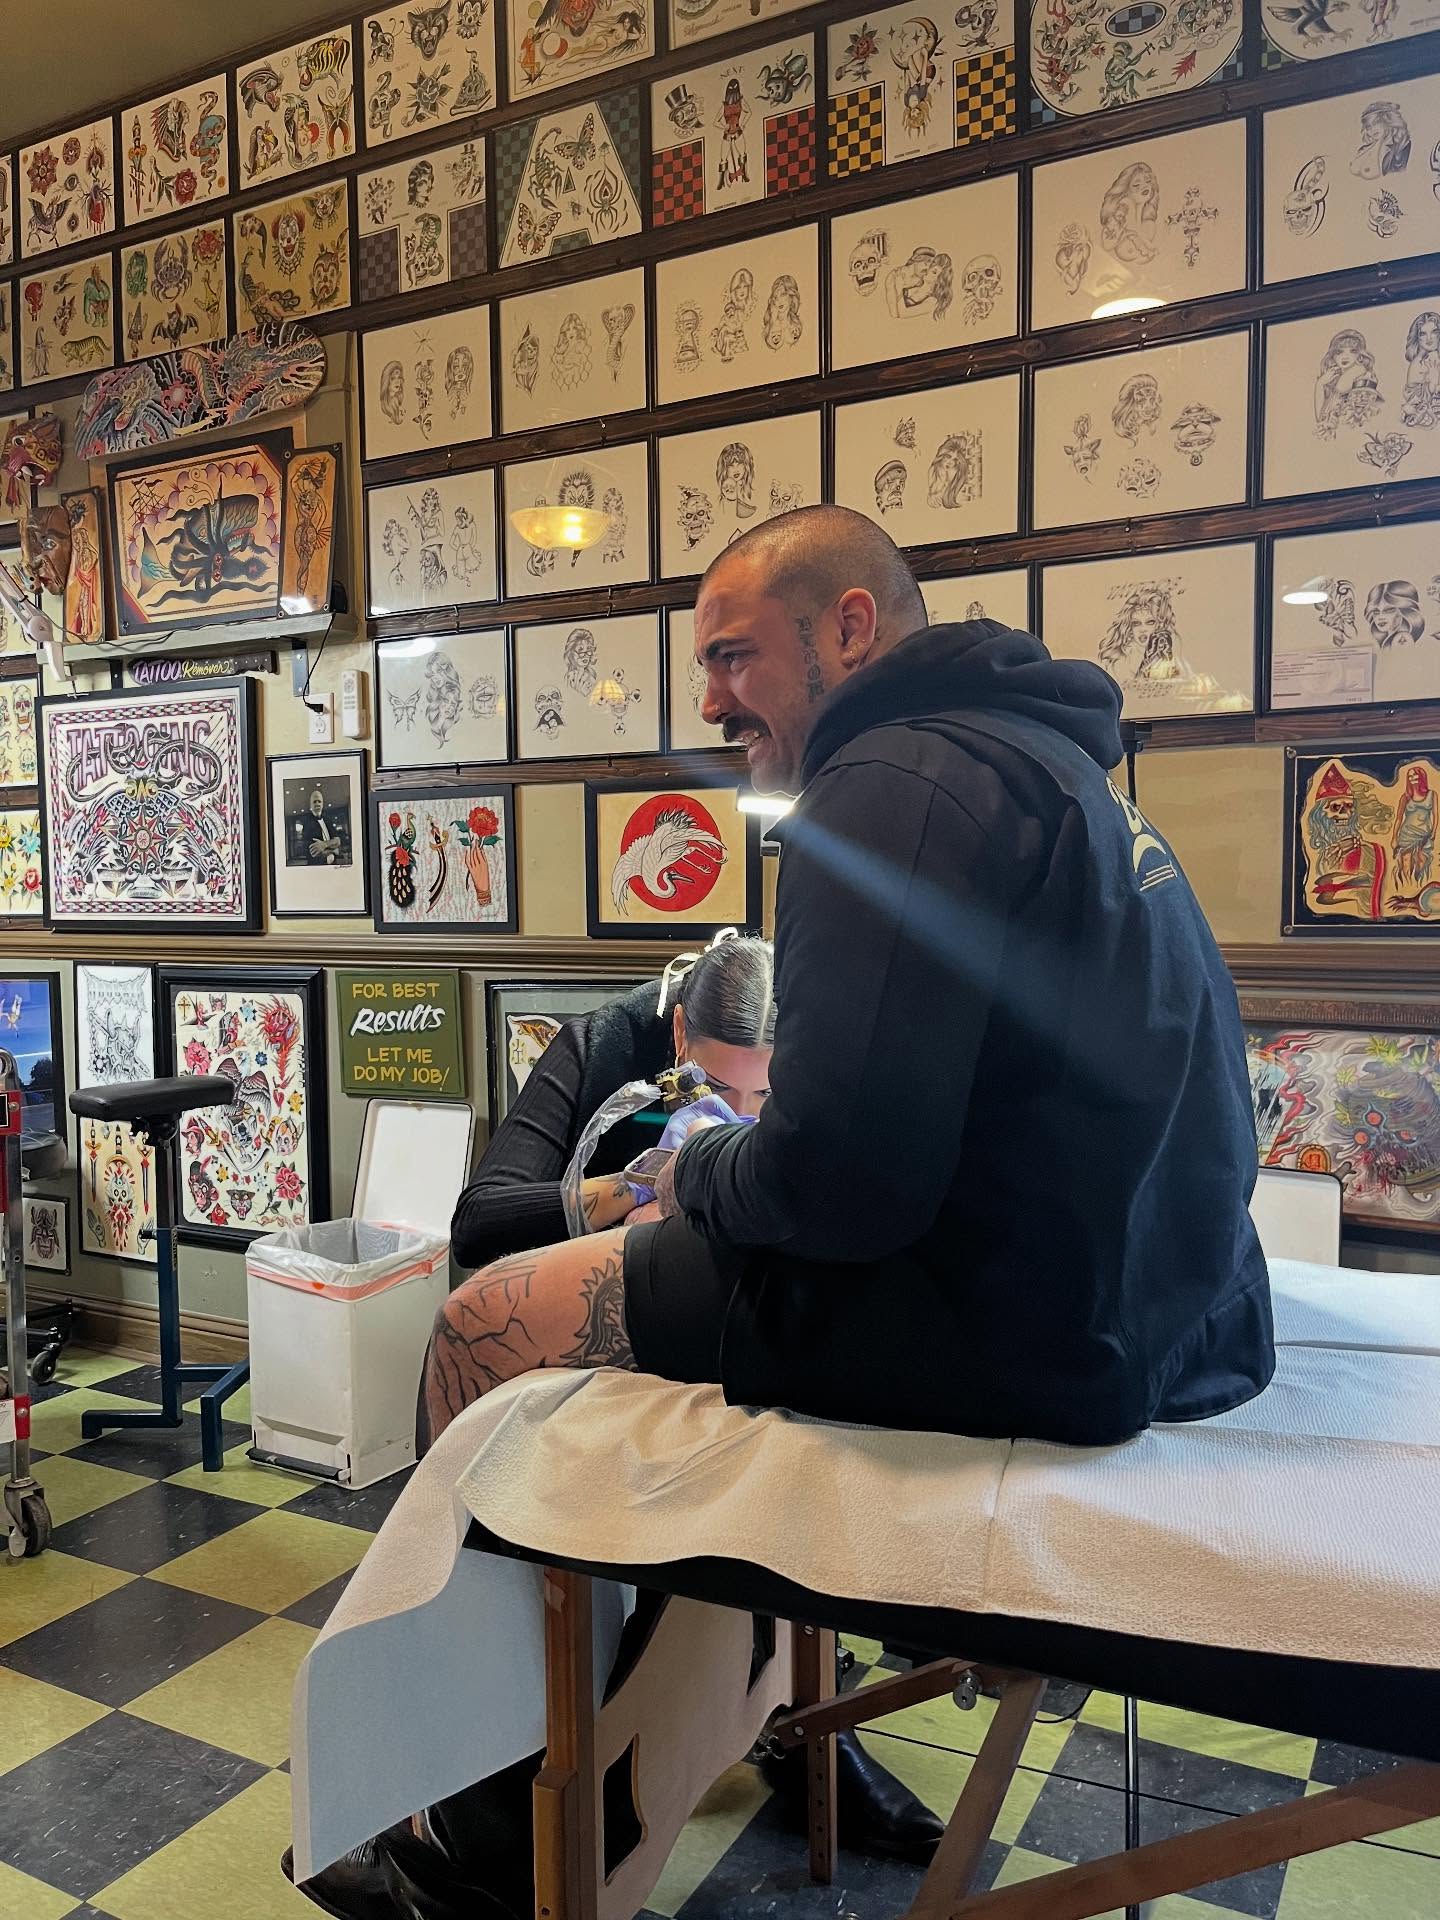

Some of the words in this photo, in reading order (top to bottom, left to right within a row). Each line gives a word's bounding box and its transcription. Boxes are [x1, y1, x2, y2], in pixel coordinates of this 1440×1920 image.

[352, 983, 388, 999] FOR
[392, 982, 440, 998] BEST
[350, 1003, 446, 1037] Results
[367, 1047, 403, 1062] LET
[406, 1048, 433, 1063] ME
[353, 1065, 378, 1081] DO
[380, 1066, 406, 1081] MY
[411, 1066, 450, 1091] JOB!
